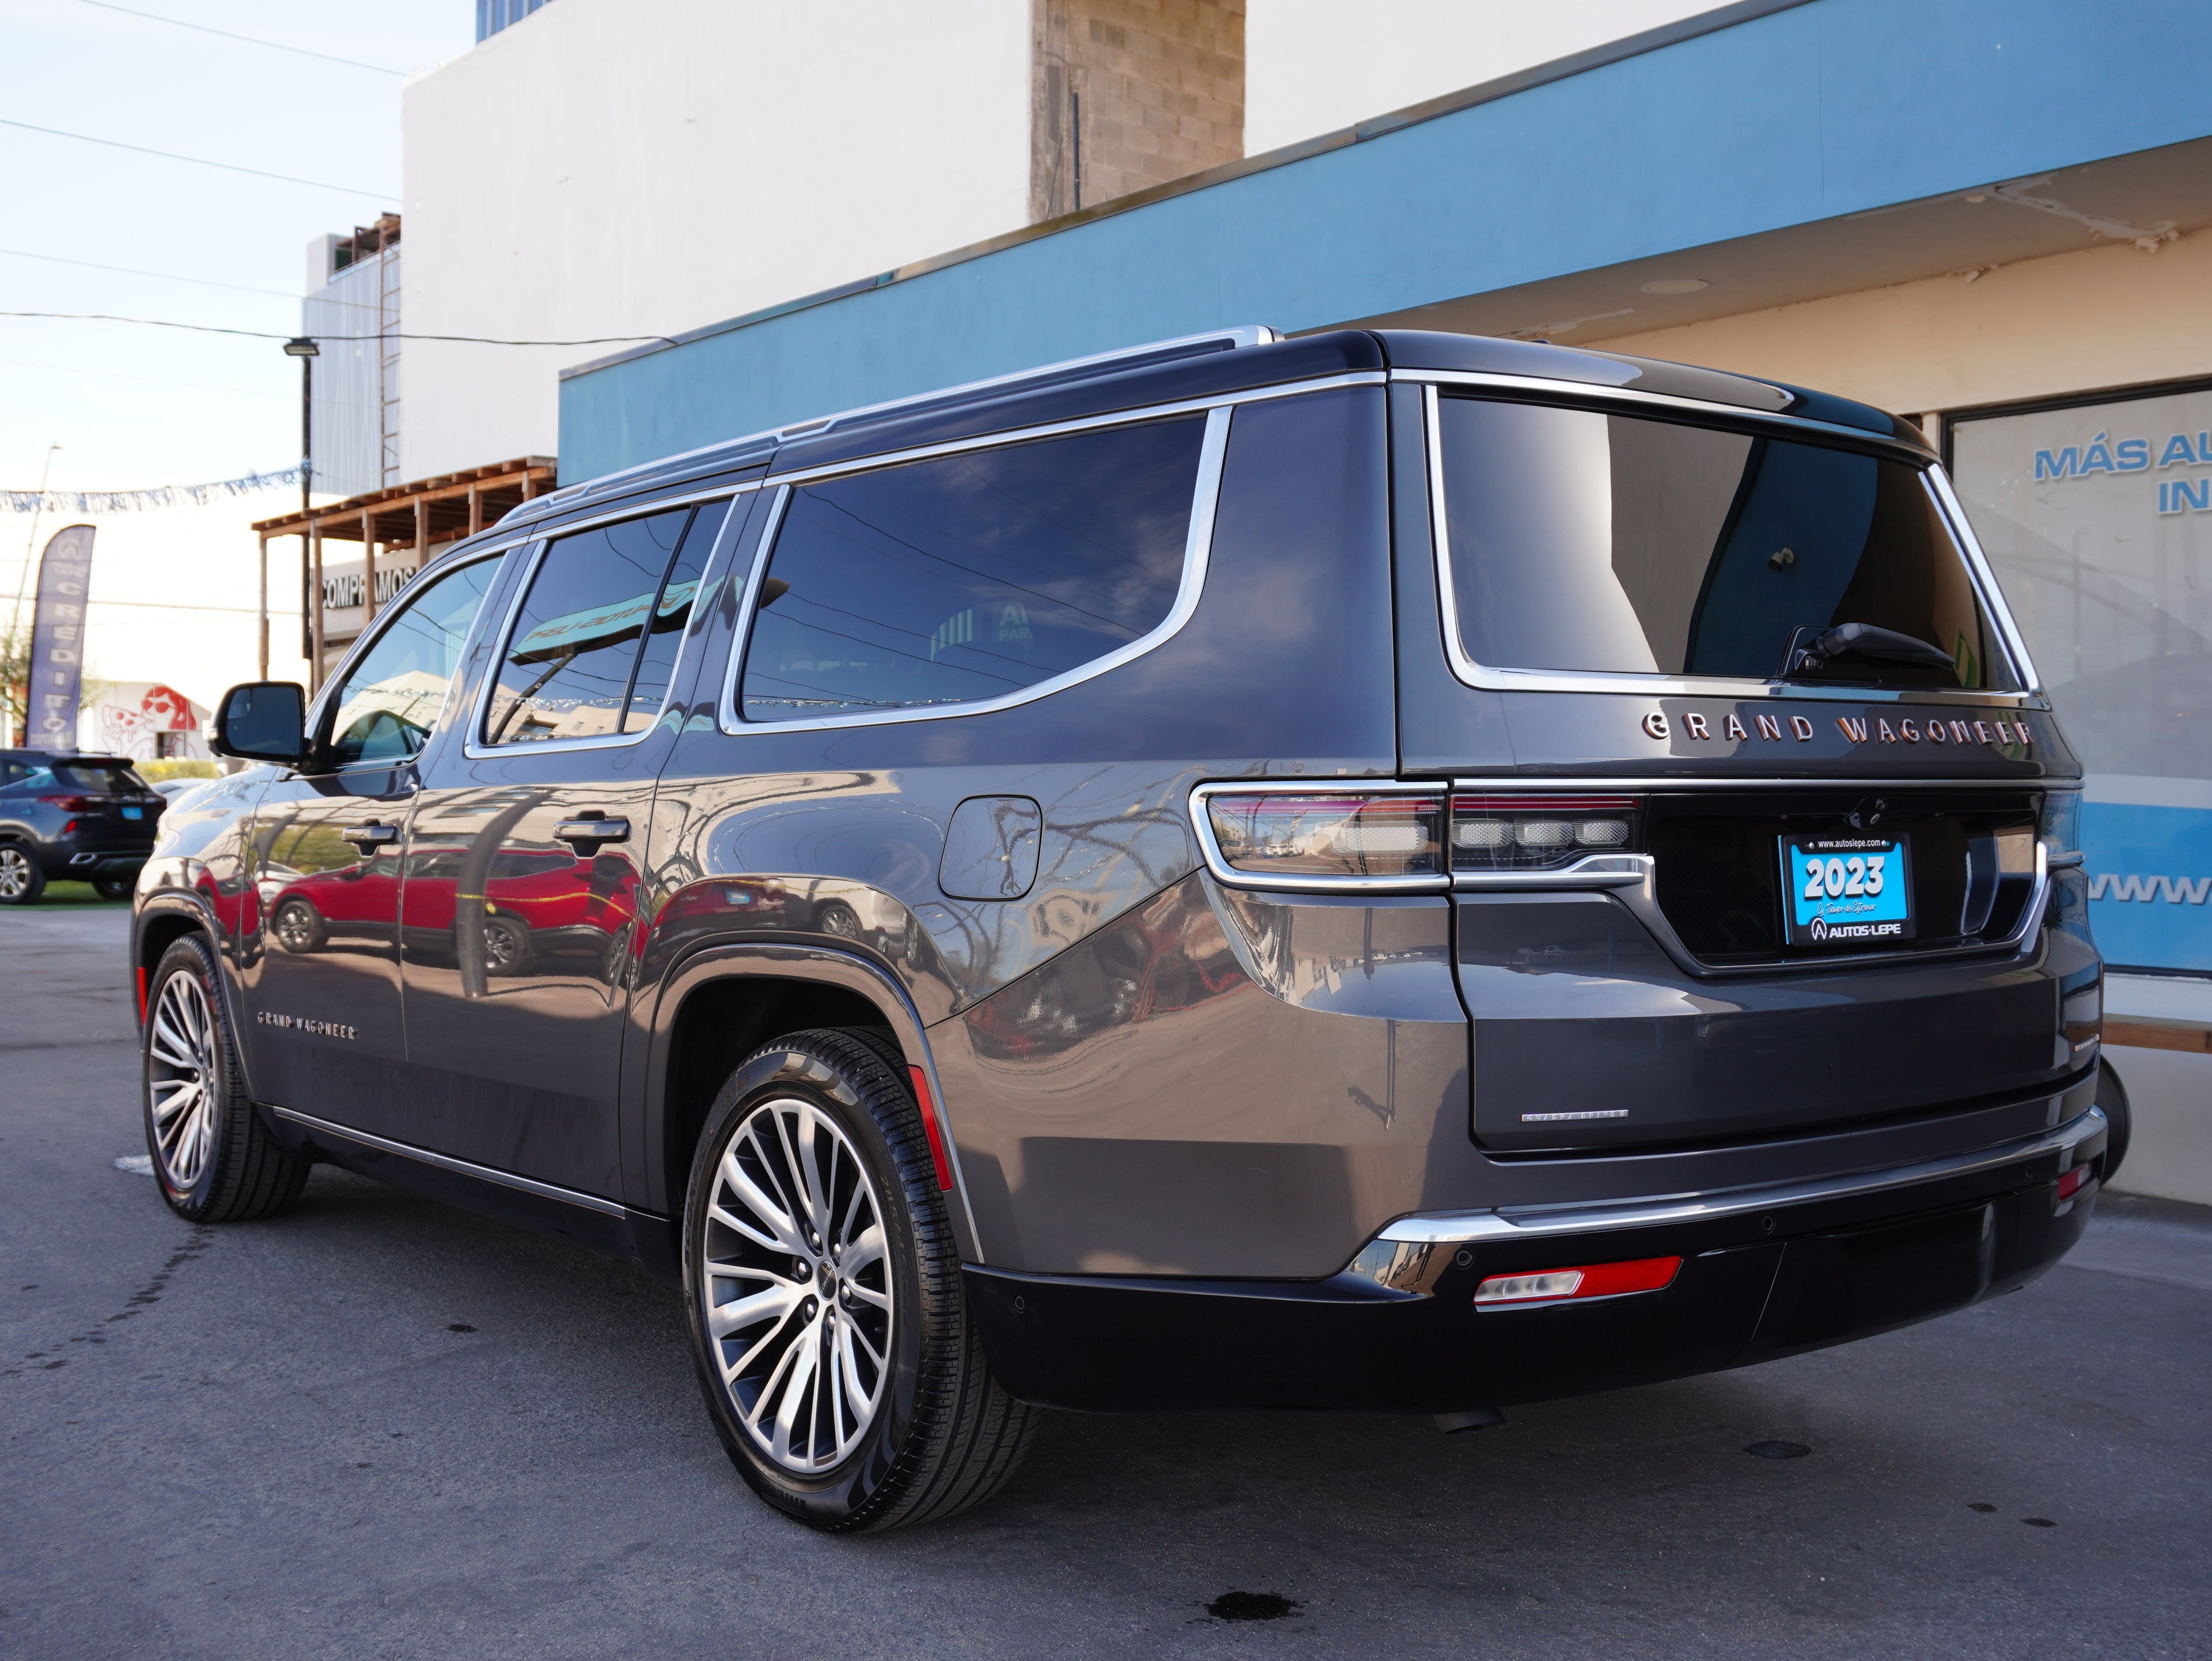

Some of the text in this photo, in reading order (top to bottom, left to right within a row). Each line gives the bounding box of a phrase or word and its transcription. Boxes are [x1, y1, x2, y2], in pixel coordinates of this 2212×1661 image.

[2035, 429, 2150, 480] MÁS
[1642, 711, 2033, 746] GRAND WAGONEER
[1817, 838, 1881, 850] www.autoslepe.com
[1804, 856, 1885, 898] 2023
[257, 1011, 358, 1039] GRAND WAGONEER
